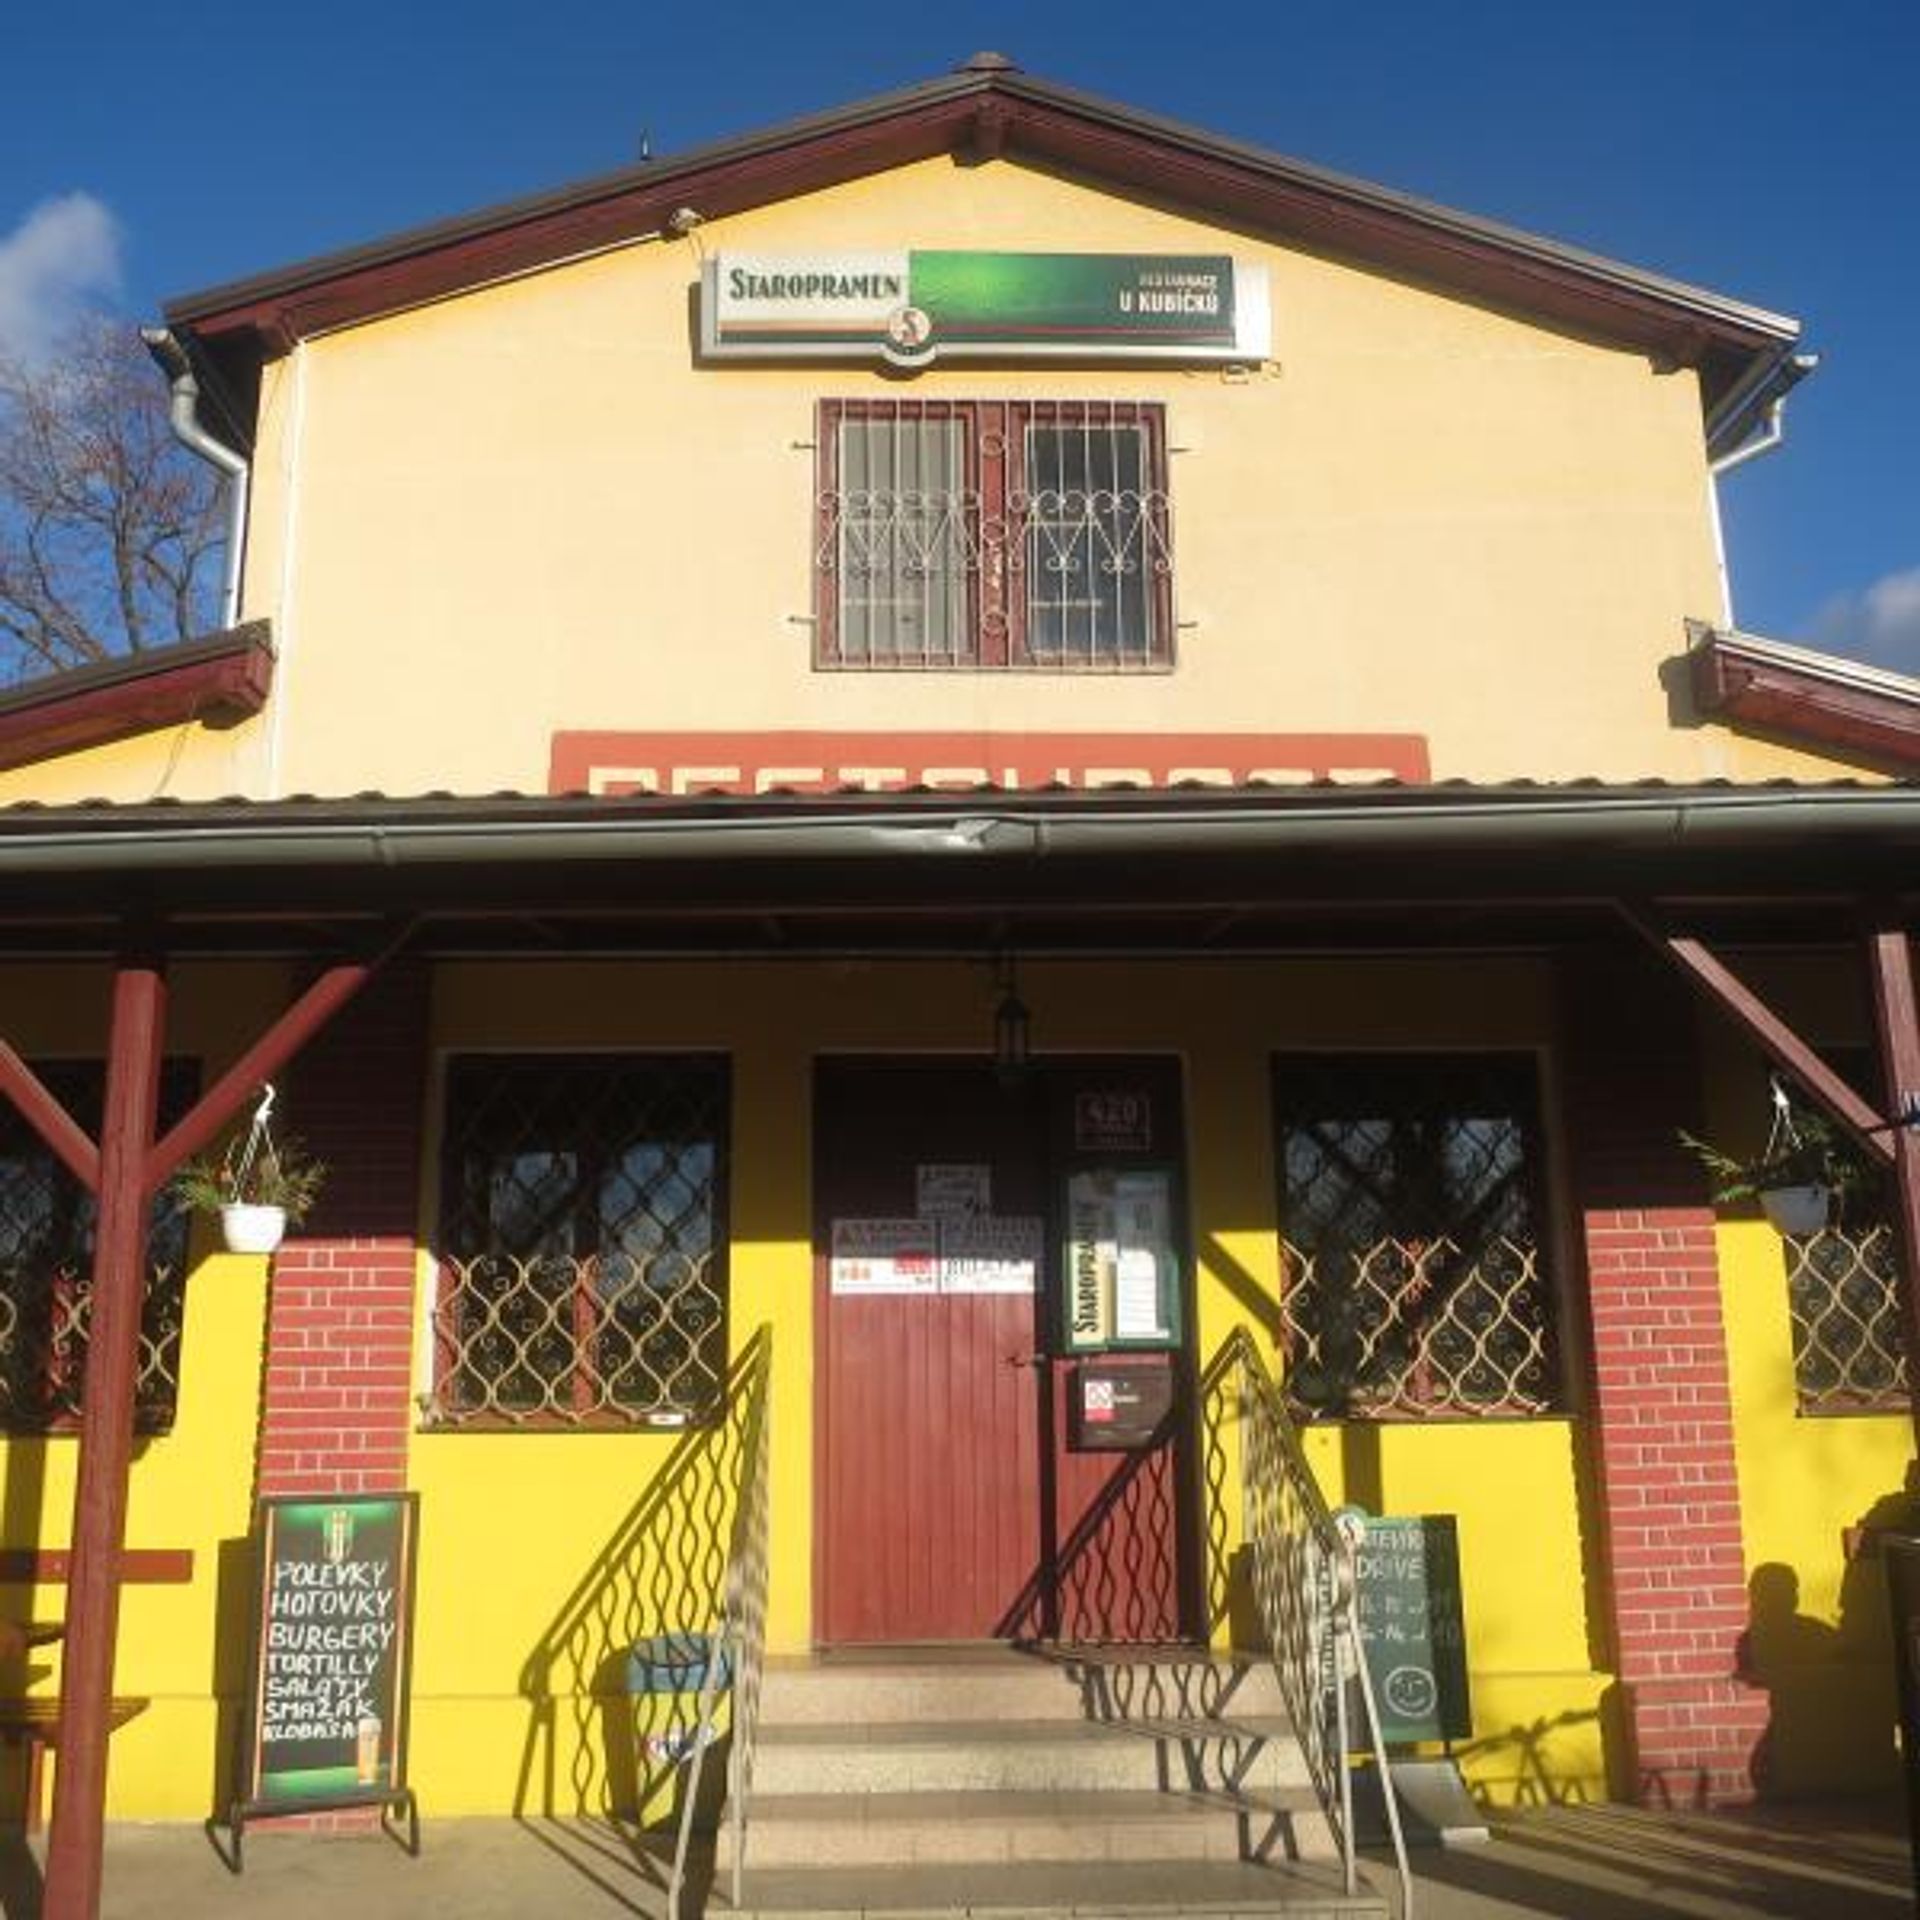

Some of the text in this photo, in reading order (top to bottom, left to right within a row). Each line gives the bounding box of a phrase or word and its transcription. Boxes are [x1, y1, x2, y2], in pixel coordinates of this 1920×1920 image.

[730, 268, 900, 299] STAROPRAMEN
[1119, 290, 1132, 312] U
[271, 1588, 393, 1617] HOTOVKY
[268, 1622, 395, 1650] BURGERY
